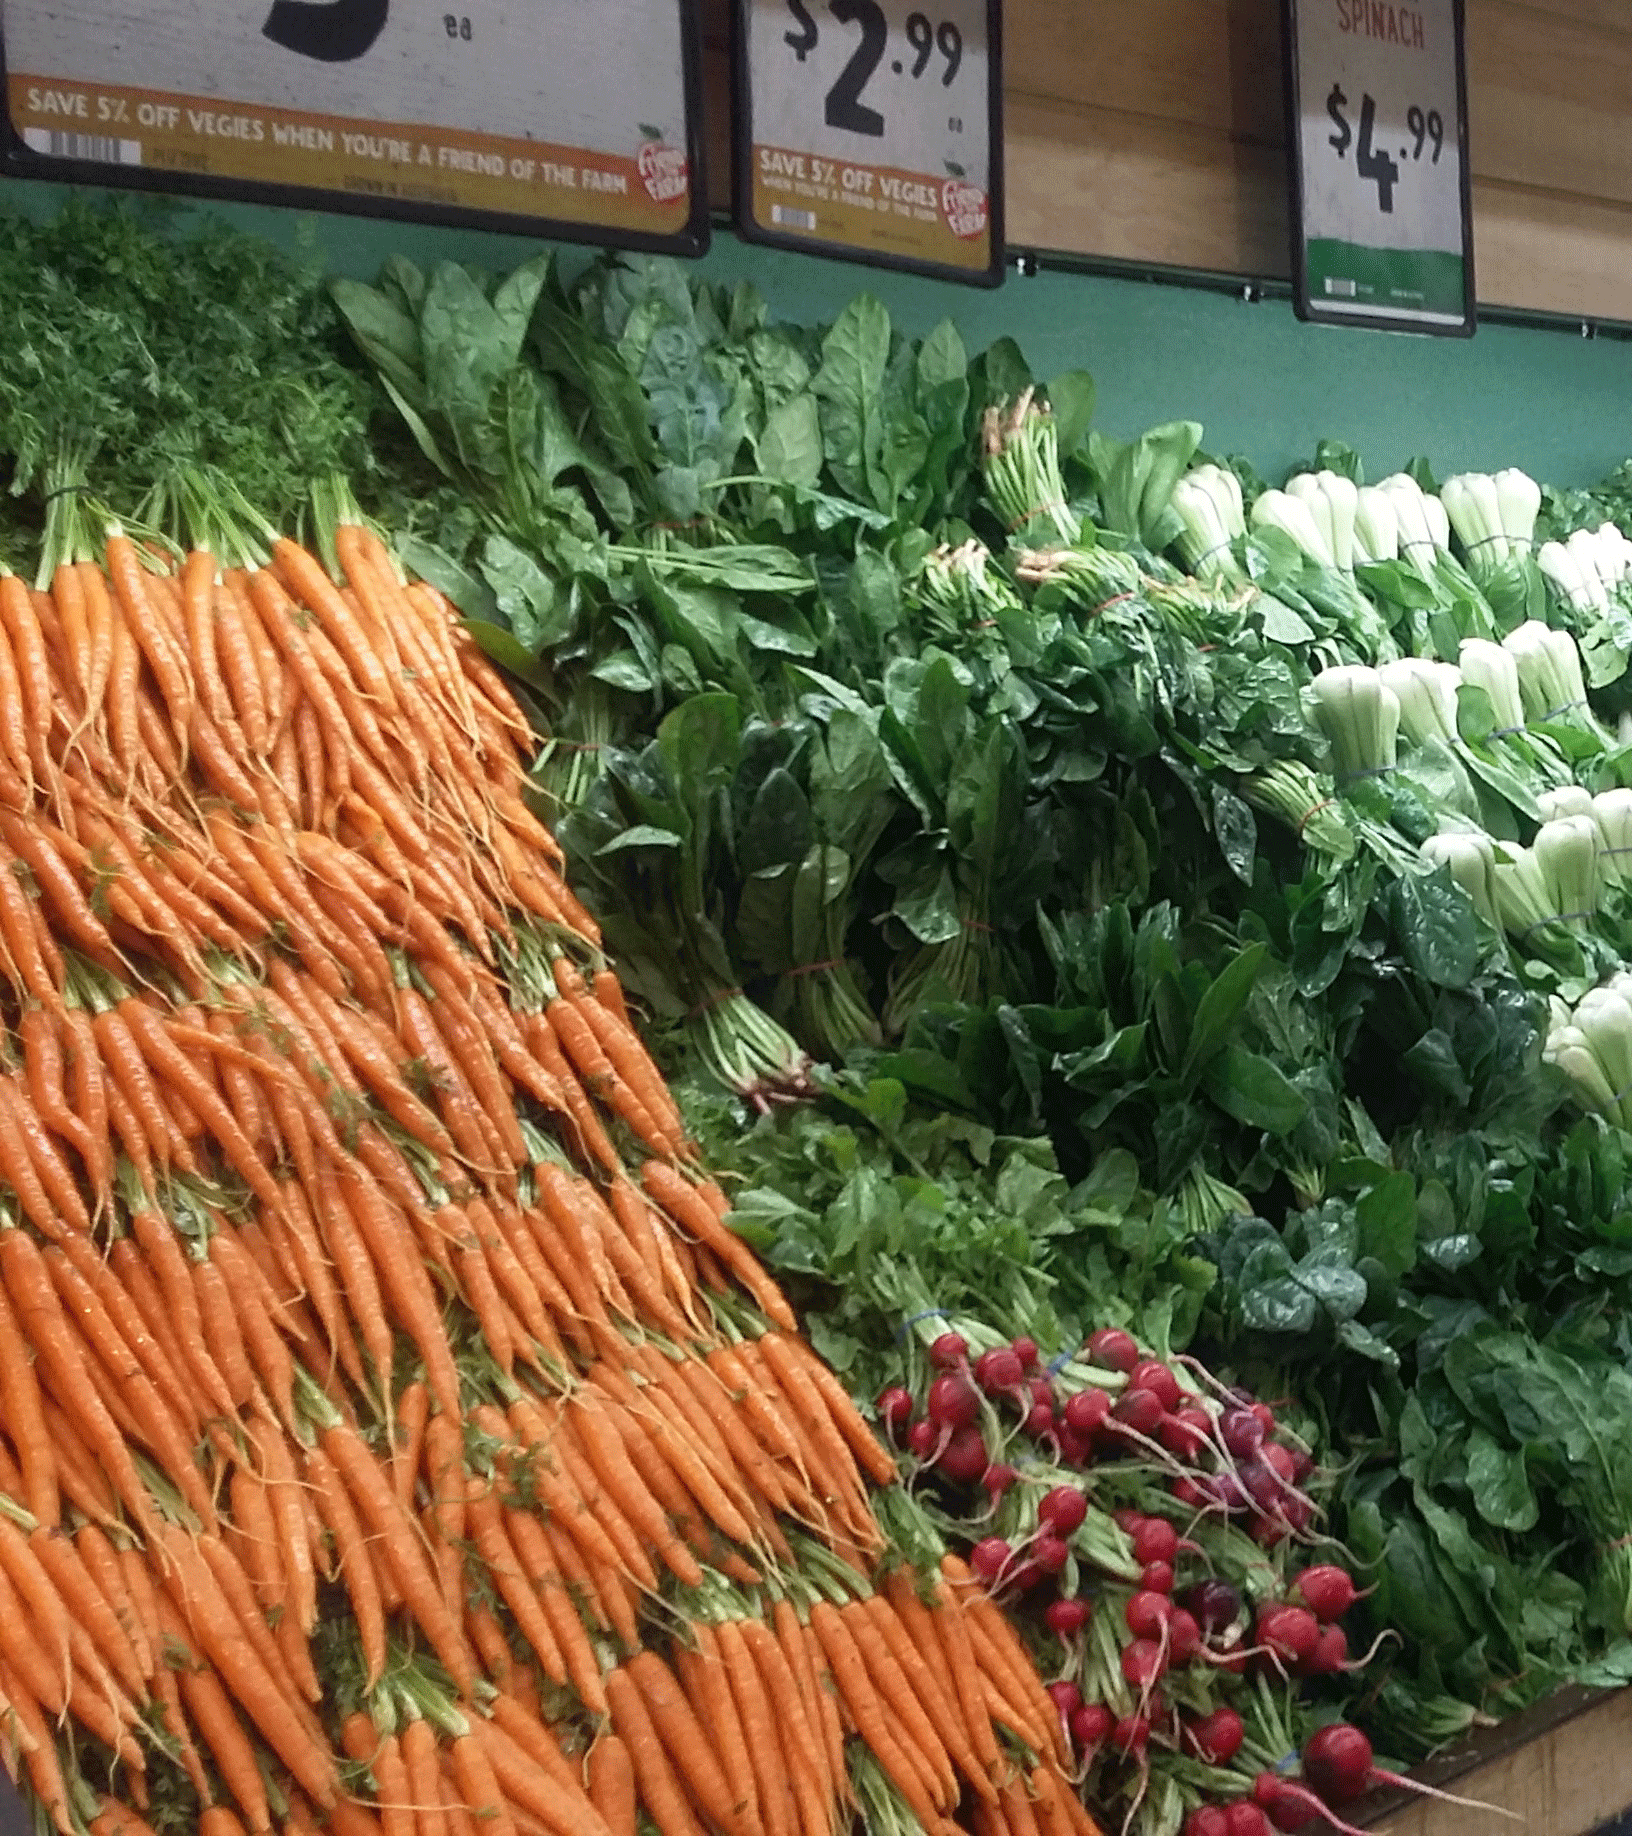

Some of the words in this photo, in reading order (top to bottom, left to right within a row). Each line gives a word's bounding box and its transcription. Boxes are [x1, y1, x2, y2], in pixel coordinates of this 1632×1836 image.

[443, 14, 472, 41] ea
[1336, 0, 1424, 50] SPINACH
[27, 87, 88, 118] SAVE
[97, 96, 131, 124] 5%
[137, 103, 181, 130] OFF
[188, 109, 264, 142] VEGIES
[272, 122, 333, 151] WHEN
[341, 132, 412, 165] YOU'RE
[418, 144, 431, 167] A
[438, 147, 504, 177] FRIEND
[510, 158, 535, 181] OF
[541, 163, 577, 187] THE
[582, 170, 628, 195] FARM
[1327, 83, 1443, 213] $4.99
[761, 150, 805, 178] SAVE
[811, 159, 836, 184] 5%
[842, 167, 874, 192] OFF
[879, 177, 937, 207] VEGIES
